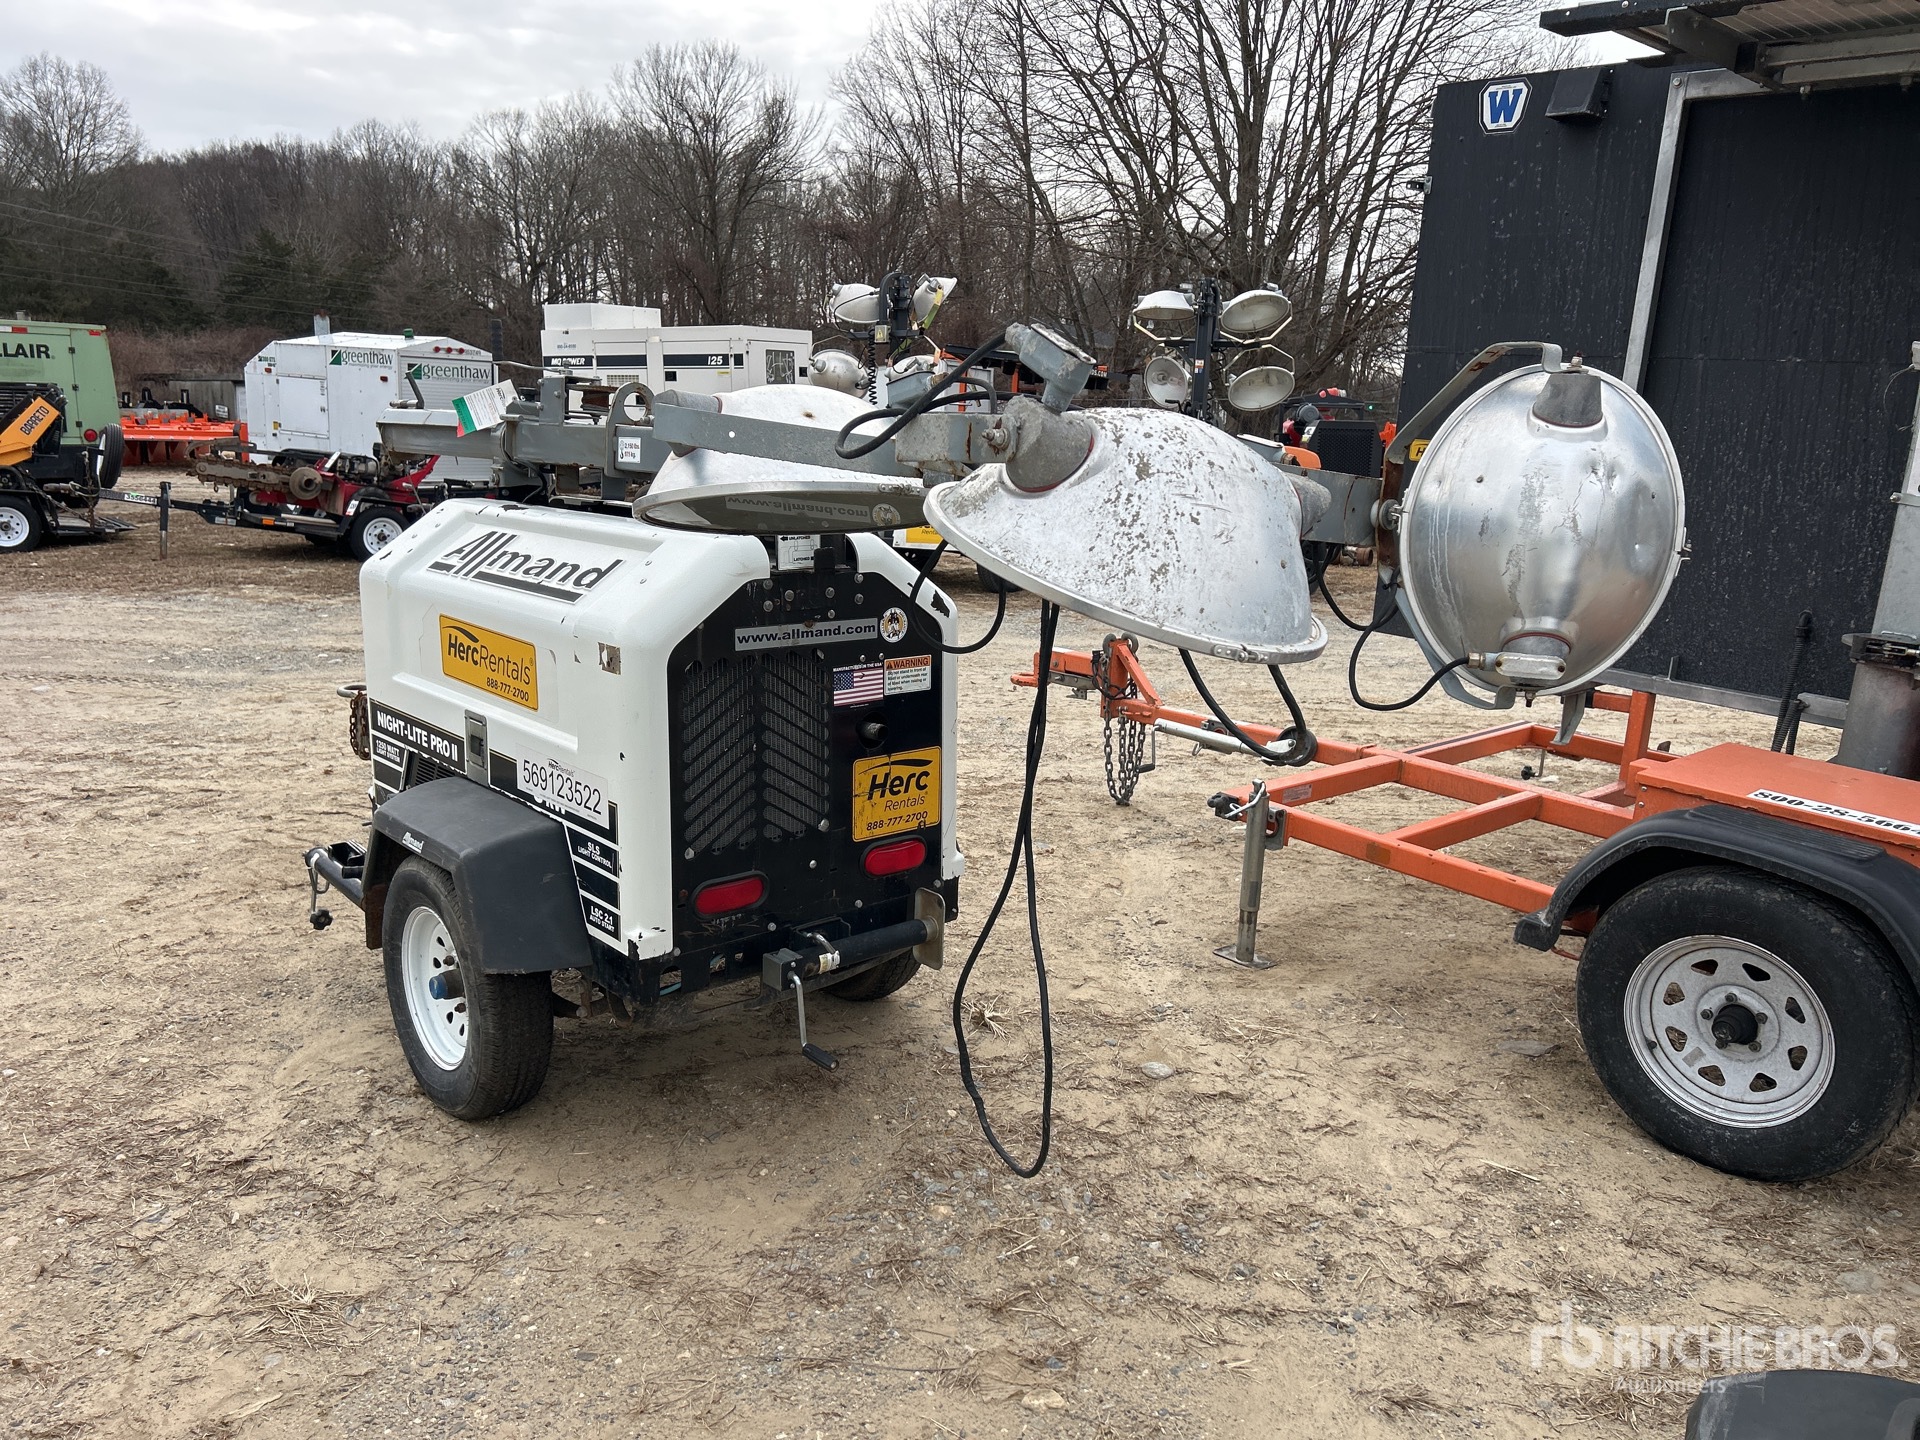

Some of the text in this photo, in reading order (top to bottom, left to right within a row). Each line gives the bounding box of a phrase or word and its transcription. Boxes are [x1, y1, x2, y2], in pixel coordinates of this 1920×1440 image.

[1488, 88, 1523, 124] W
[0, 342, 51, 359] LAIR
[341, 350, 393, 366] greenthaw
[707, 356, 723, 365] 125
[422, 363, 491, 380] greenthaw
[20, 405, 50, 436] BARRETO
[440, 530, 626, 590] Allmand
[736, 623, 876, 645] www.allmand.com
[447, 633, 533, 686] HercRentals
[893, 657, 929, 669] WARNING
[486, 676, 530, 703] 888-777-2700
[376, 710, 458, 762] NIGHT-LITE PRO II
[386, 743, 400, 757] WATT
[523, 758, 602, 816] 569123522
[867, 769, 931, 801] Herc
[884, 794, 926, 813] Rentals
[866, 810, 929, 831] 888-777-2700
[577, 845, 613, 869] LIGHT CONTROL
[587, 841, 600, 855] SLS
[589, 915, 615, 933] AUTO START
[590, 905, 613, 926] LSC 2.1
